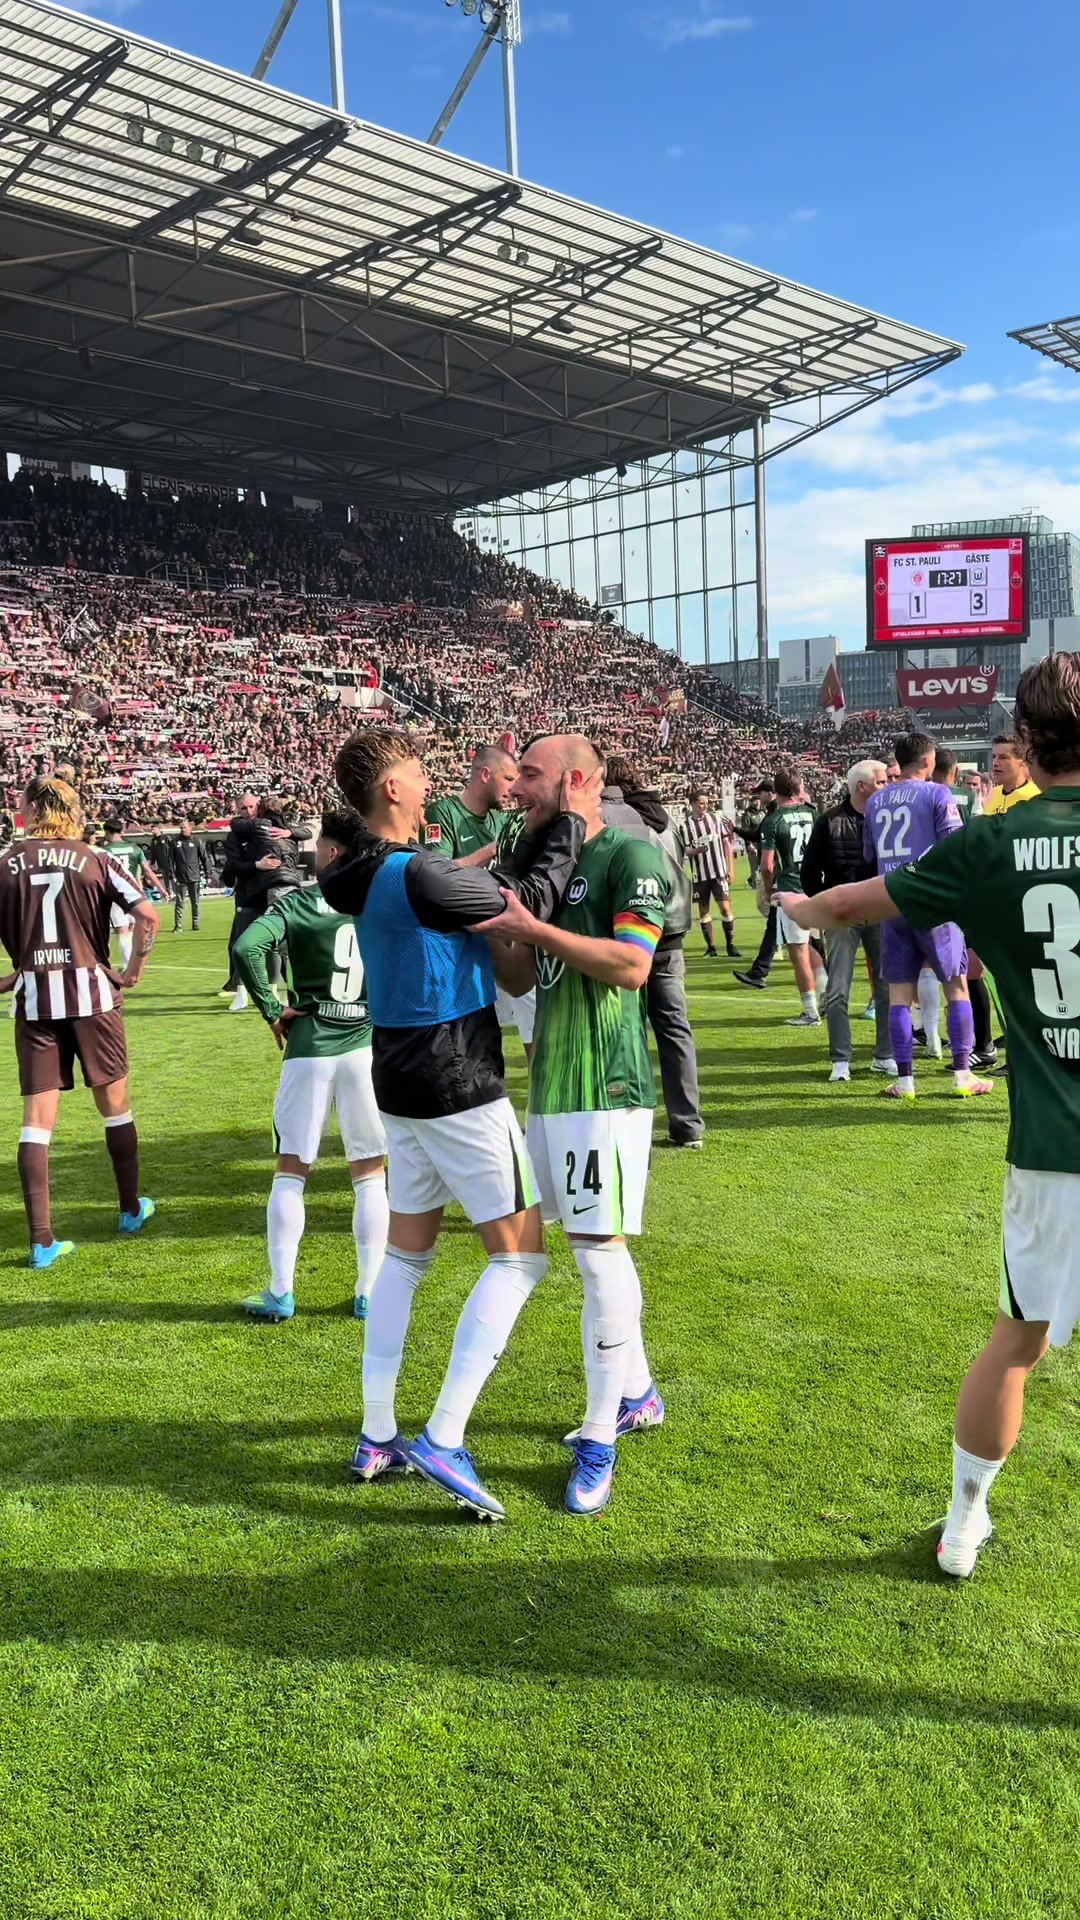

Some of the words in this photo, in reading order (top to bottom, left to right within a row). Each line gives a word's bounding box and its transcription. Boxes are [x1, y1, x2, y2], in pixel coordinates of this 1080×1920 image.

[21, 457, 58, 469] UNTER
[893, 559, 904, 567] FC
[905, 558, 917, 566] ST.
[919, 556, 941, 565] PAULI
[965, 554, 990, 563] GÄSTE
[937, 571, 962, 585] 17:27
[914, 596, 921, 613] 1
[973, 593, 984, 610] 3
[874, 794, 886, 809] ST.
[888, 789, 919, 804] PAULI
[875, 805, 912, 858] 22
[7, 852, 34, 875] ST.
[38, 848, 88, 873] PAULI
[29, 872, 65, 943] 7
[33, 949, 72, 965] IRVINE
[330, 923, 365, 1003] 9
[566, 1150, 602, 1195] 24
